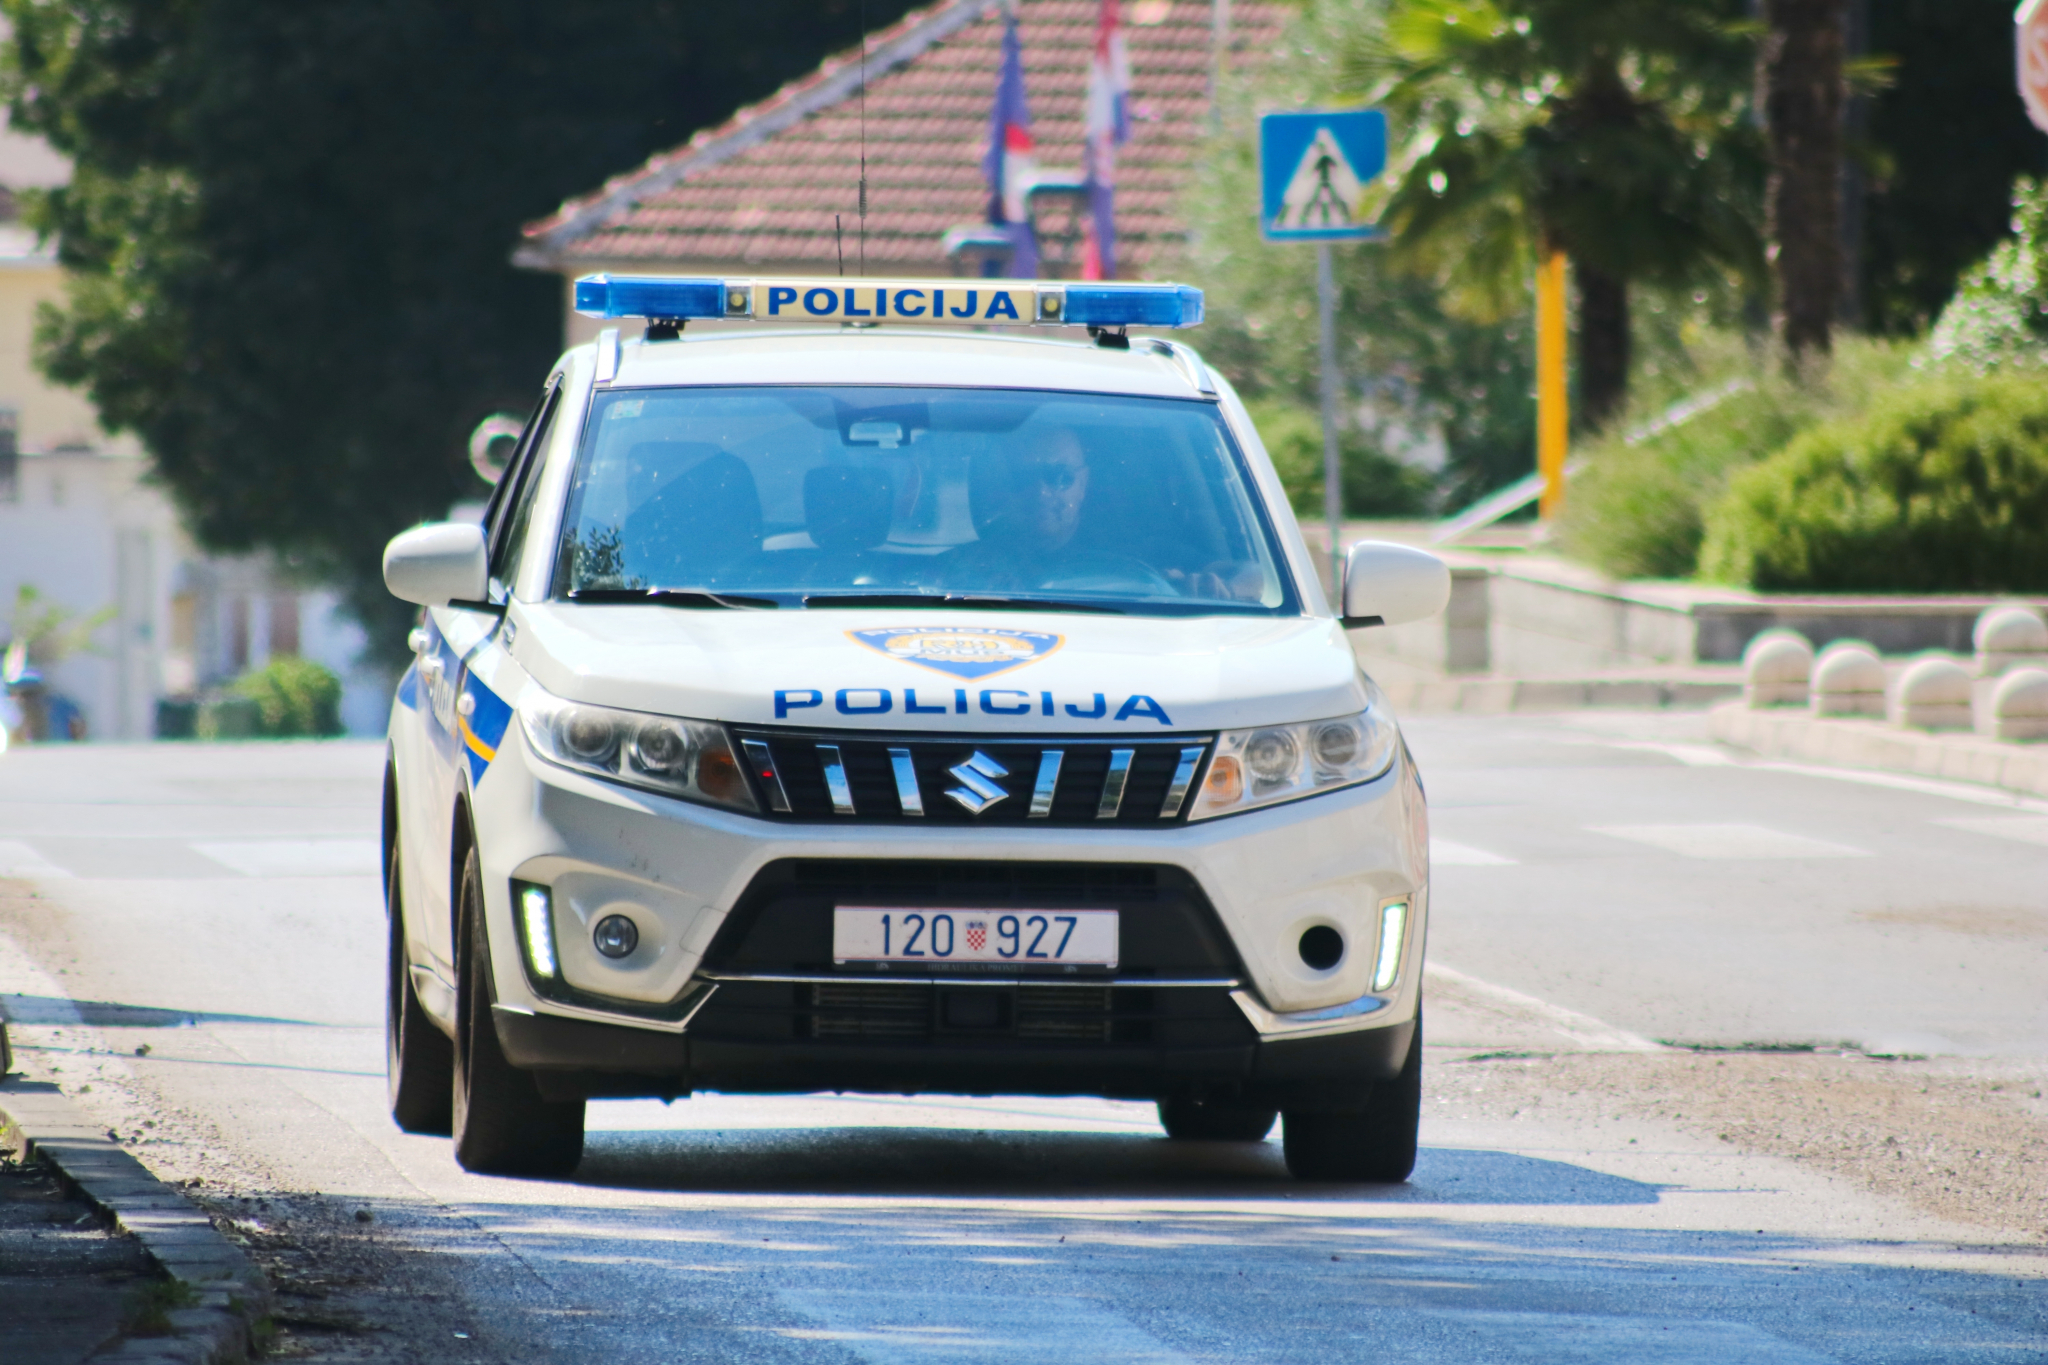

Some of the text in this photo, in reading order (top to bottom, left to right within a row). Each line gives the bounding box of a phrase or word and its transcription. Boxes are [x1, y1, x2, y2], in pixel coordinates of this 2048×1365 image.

[768, 287, 1020, 320] POLICIJA
[861, 627, 1050, 640] POLICIJA
[774, 688, 1174, 726] POLICIJA
[881, 914, 1078, 958] 120 927
